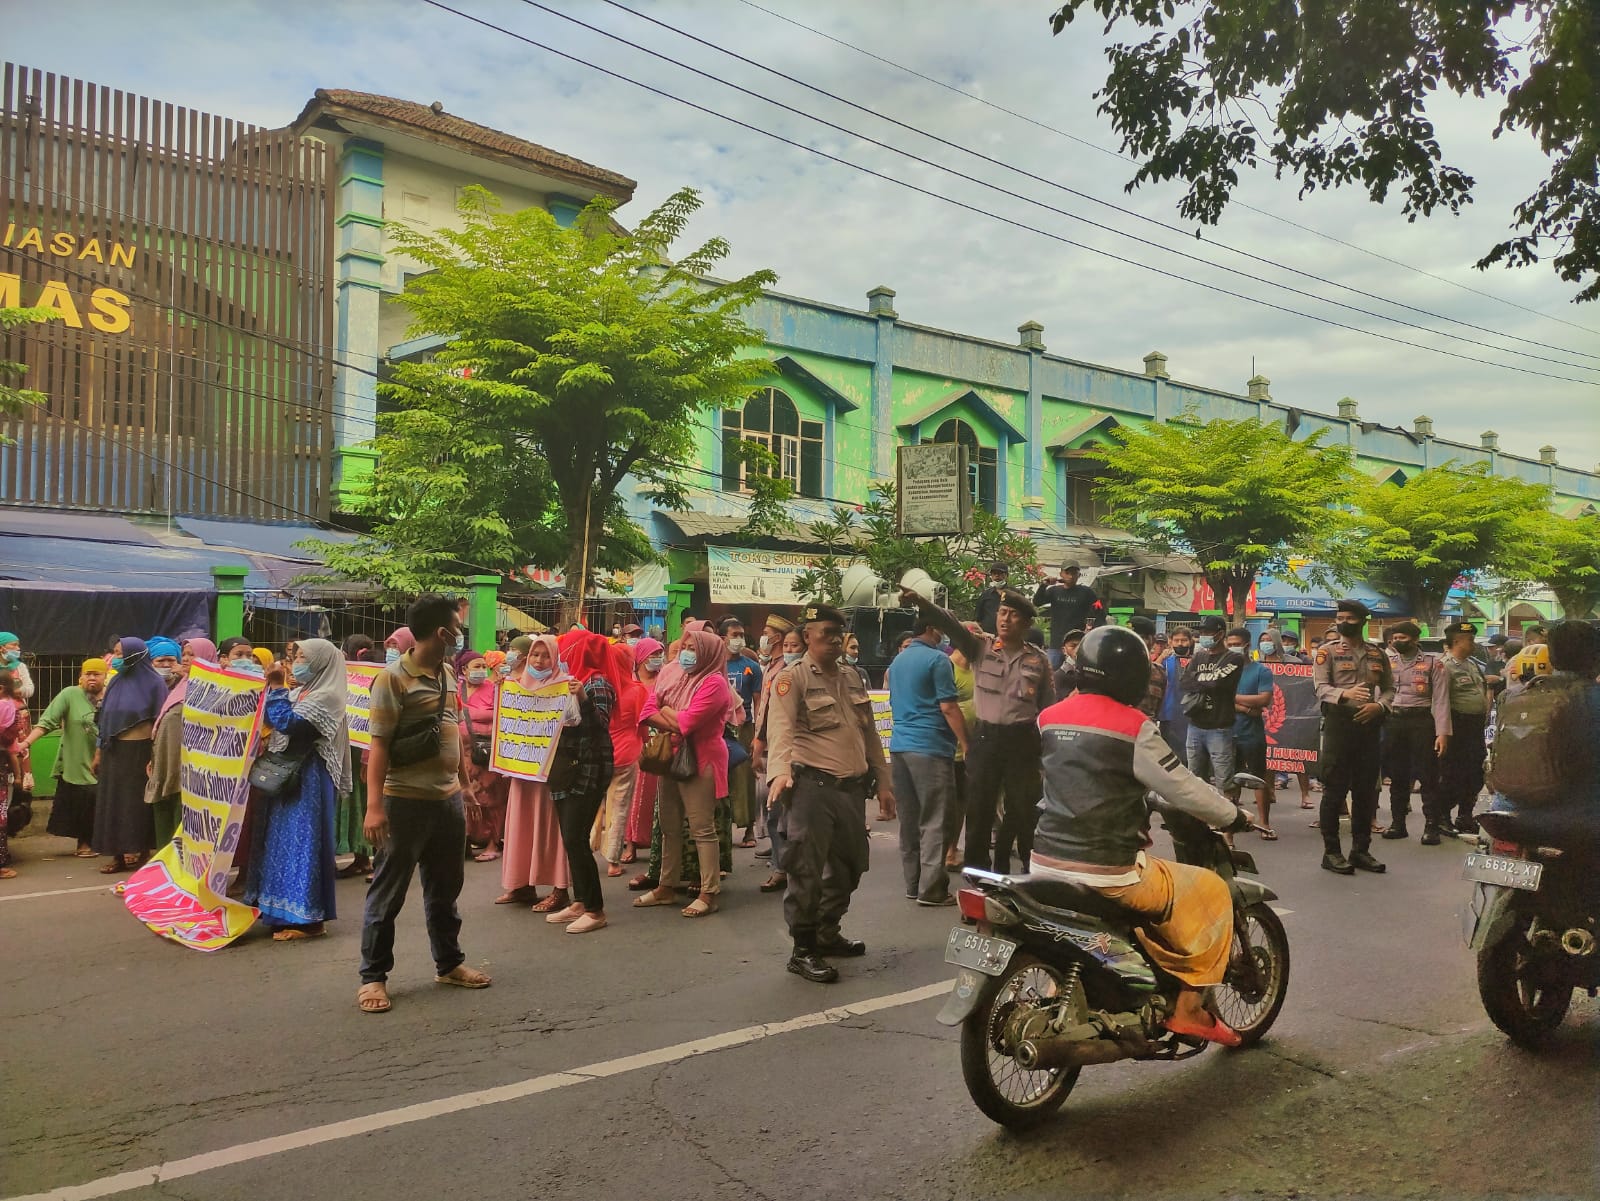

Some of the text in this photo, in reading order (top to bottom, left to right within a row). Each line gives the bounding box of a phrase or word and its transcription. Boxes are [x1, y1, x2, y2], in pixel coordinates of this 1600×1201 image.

[3, 223, 137, 269] IASAN
[729, 551, 770, 564] TOKO
[1273, 747, 1318, 762] HUKUM
[1485, 858, 1514, 873] 6632
[1523, 864, 1540, 877] XT
[964, 935, 991, 953] 6515
